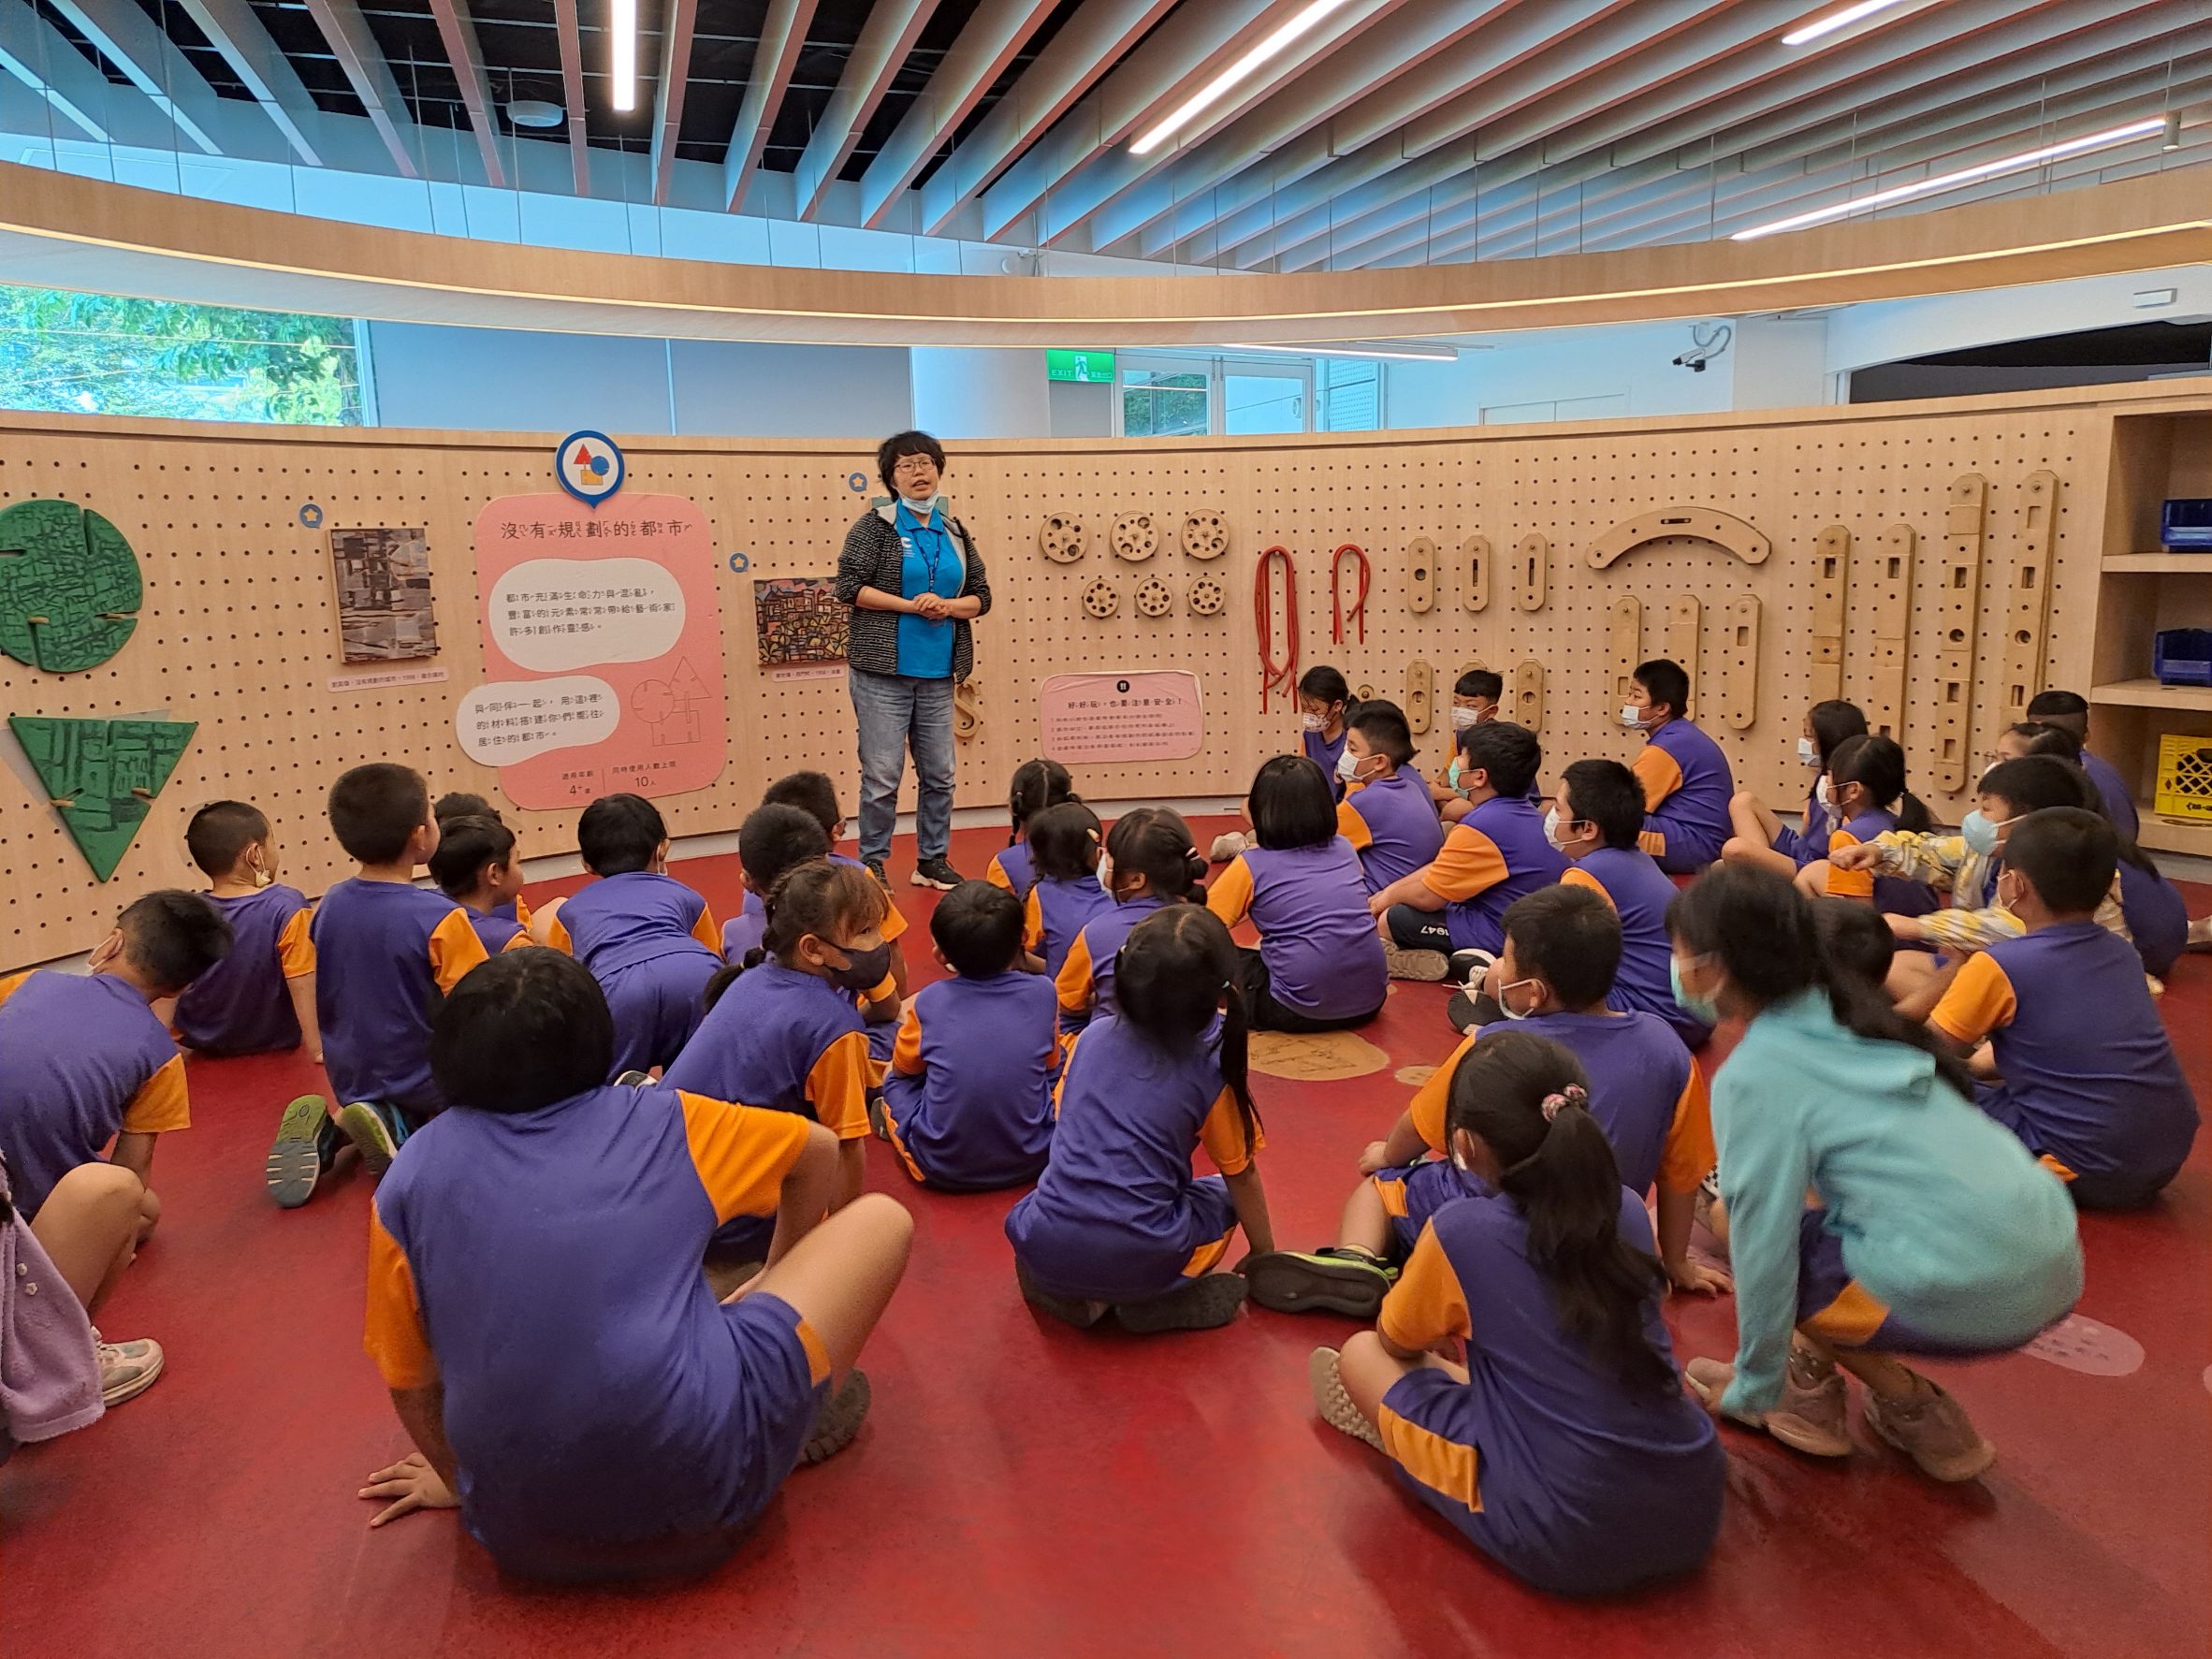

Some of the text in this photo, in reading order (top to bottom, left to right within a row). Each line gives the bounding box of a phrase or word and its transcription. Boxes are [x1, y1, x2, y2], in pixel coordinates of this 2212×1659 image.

[1051, 369, 1072, 377] EXIT
[501, 519, 685, 540] 沒有規劃的都市
